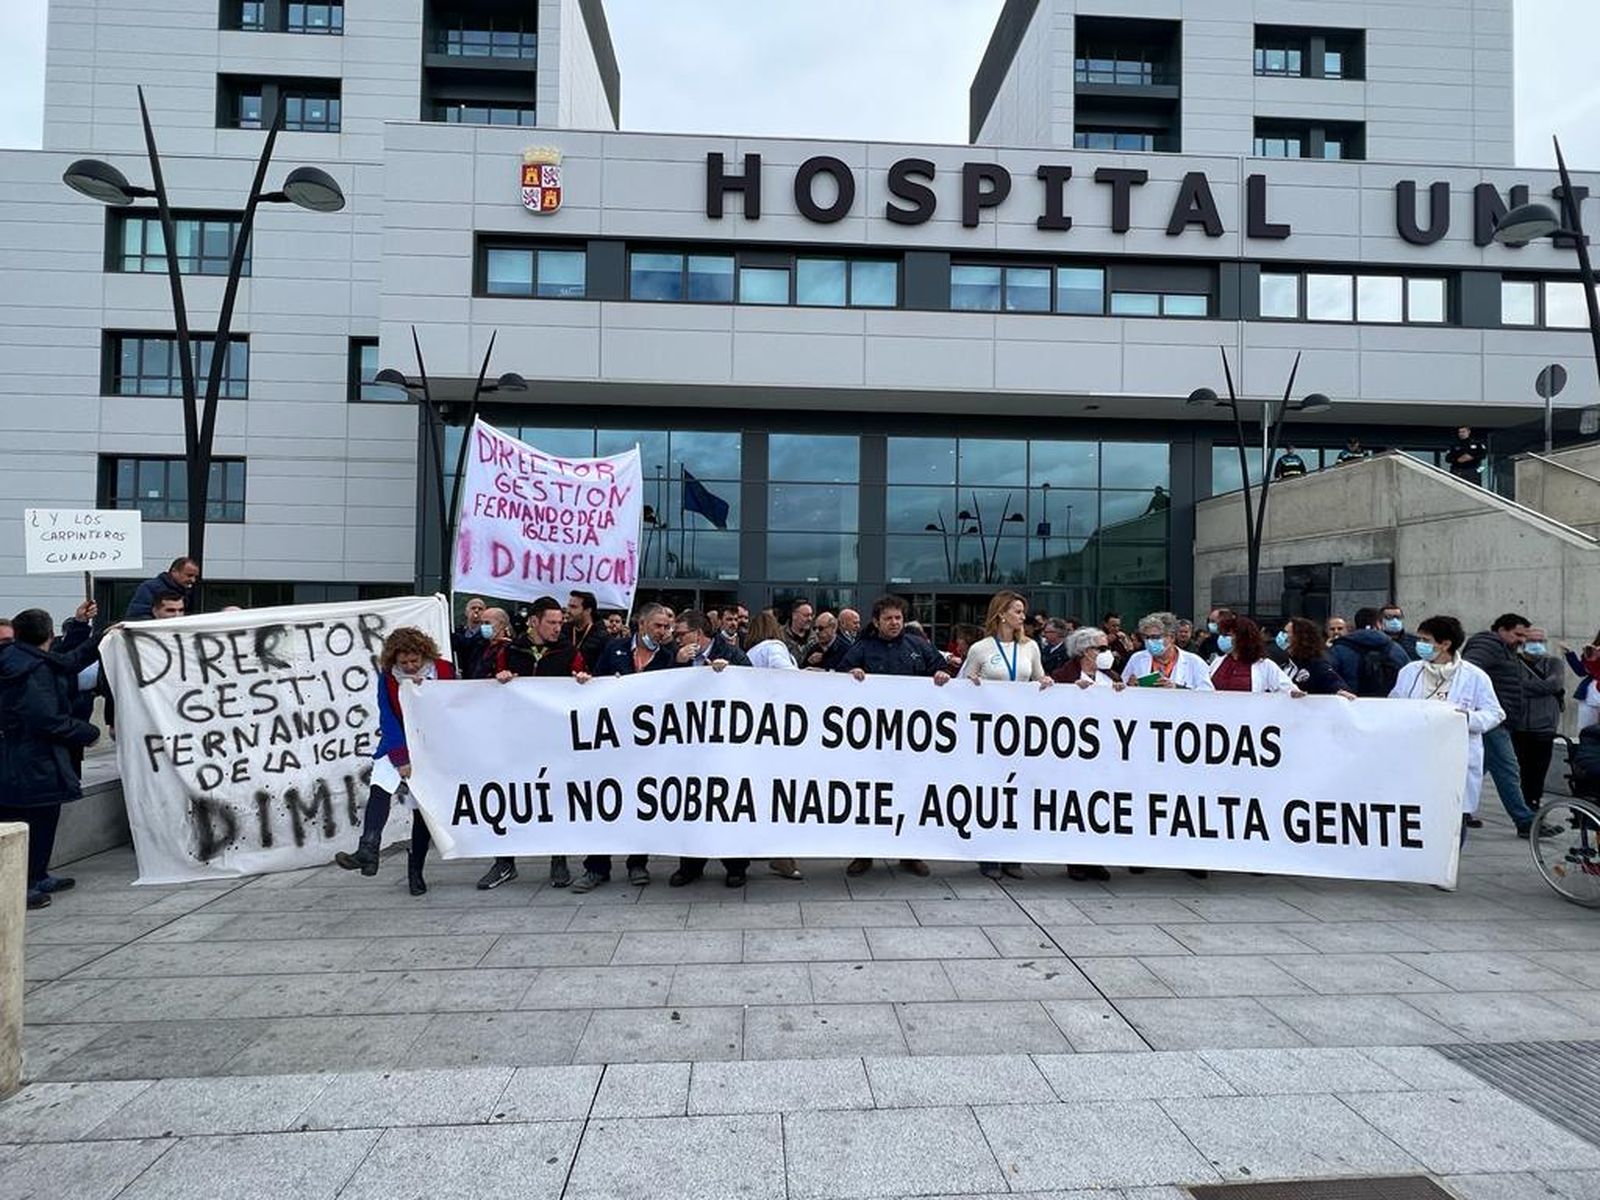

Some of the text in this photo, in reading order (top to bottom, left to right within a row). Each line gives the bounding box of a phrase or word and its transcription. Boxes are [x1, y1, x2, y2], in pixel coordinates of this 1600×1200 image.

[705, 152, 1590, 250] HOSPITAL UNI
[477, 430, 616, 483] DIRECTOR
[495, 472, 631, 508] GESTION
[40, 530, 127, 542] CARPINTEROS
[74, 513, 102, 526] LOS
[522, 523, 600, 546] IGLESIA
[144, 704, 370, 772] FERNANDO
[570, 700, 1282, 768] LA SANIDAD SOMOS TODOS Y TODAS
[196, 757, 251, 791] DE
[263, 749, 301, 773] LA
[451, 766, 1424, 849] AQUÍ NO SOBRA NADIE, AQUÍ HACE FALTA GENTE
